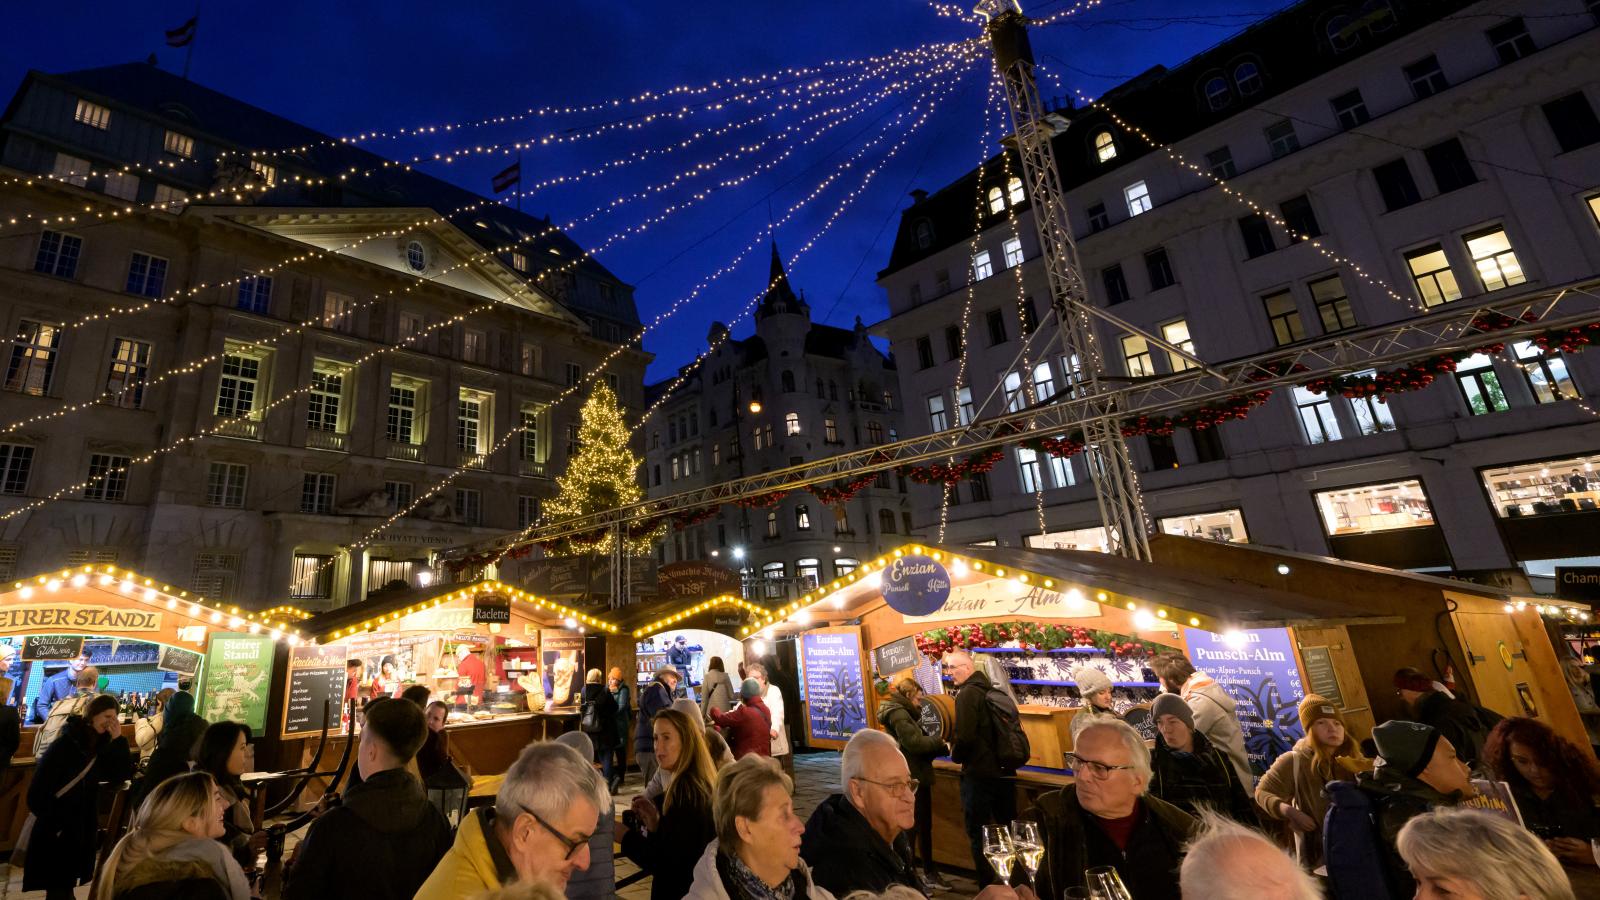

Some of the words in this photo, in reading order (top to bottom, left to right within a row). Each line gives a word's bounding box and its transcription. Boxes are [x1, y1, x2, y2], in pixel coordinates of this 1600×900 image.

[389, 535, 418, 544] HYATT
[421, 536, 453, 545] VIENNA
[891, 558, 937, 583] Enzian
[1563, 572, 1600, 586] Cham
[883, 583, 909, 598] Punsch
[941, 600, 987, 613] nzian
[1008, 586, 1063, 614] Alm
[74, 610, 156, 629] STANDL
[475, 608, 509, 621] Raclette
[224, 640, 261, 651] Steirer
[816, 636, 843, 644] Enzian
[224, 650, 260, 660] Standl
[808, 648, 855, 656] Punsch-Alm
[1195, 647, 1287, 662] Punsch-Alm
